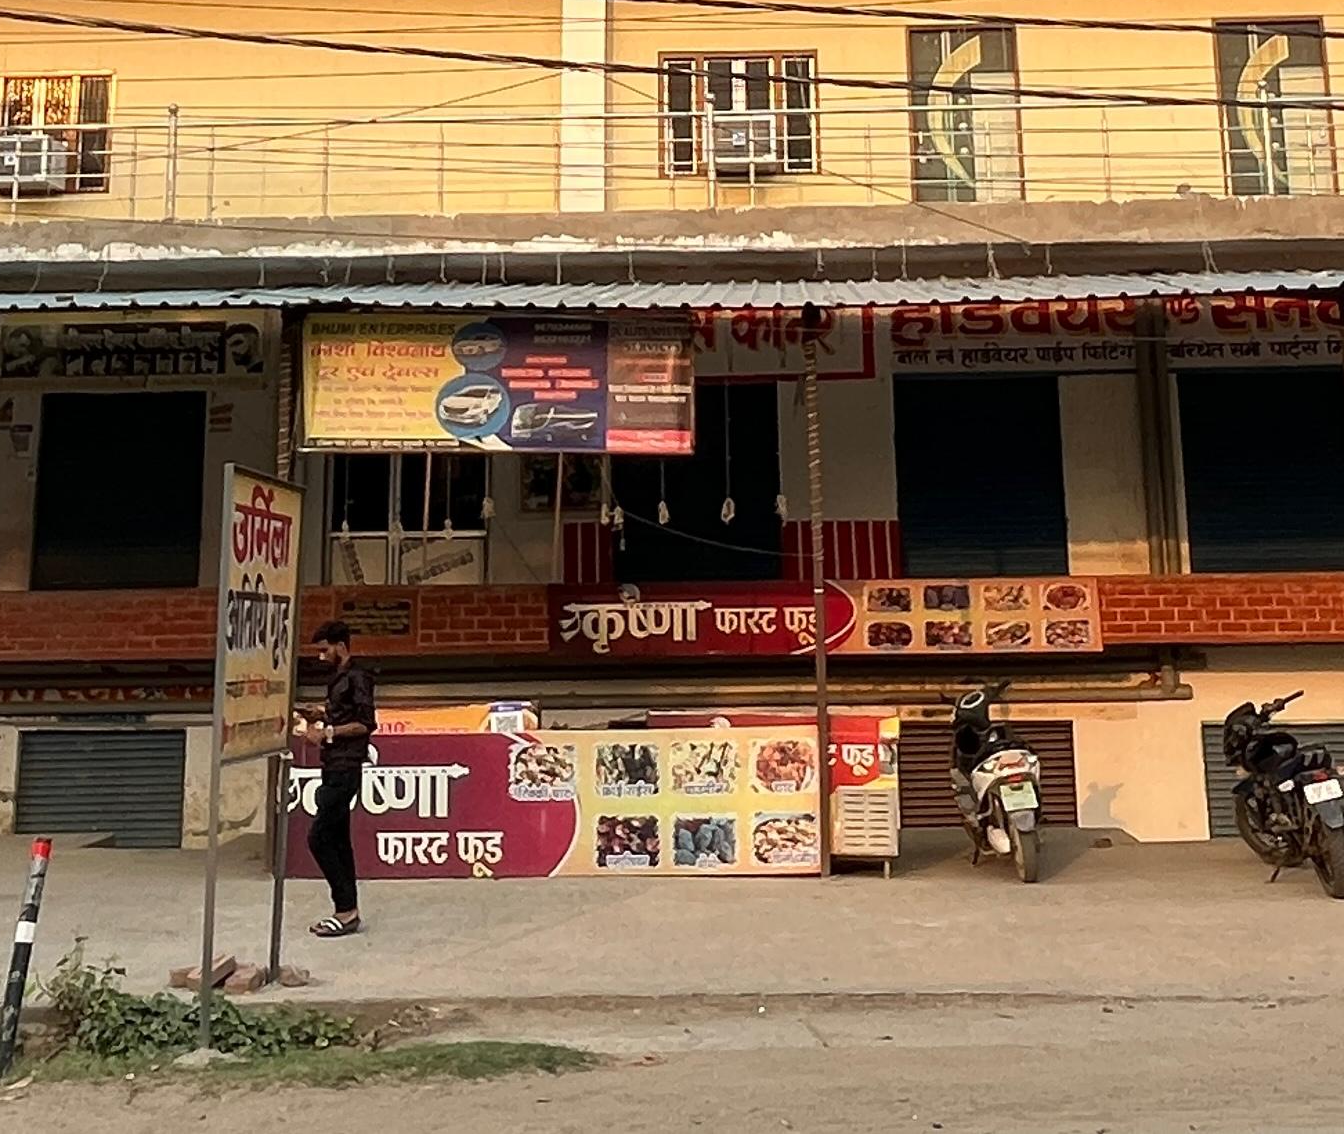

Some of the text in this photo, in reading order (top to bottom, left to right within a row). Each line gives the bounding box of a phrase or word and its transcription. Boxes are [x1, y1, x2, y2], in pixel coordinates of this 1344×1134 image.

[310, 322, 456, 336] BHUMI ENTERPRISES
[231, 484, 293, 570] उर्मिला
[226, 572, 268, 653] अतिथि
[560, 599, 713, 655] कृष्णा
[714, 607, 778, 634] फास्ट
[841, 743, 875, 777] फूड
[375, 830, 505, 879] फास्ट फूड
